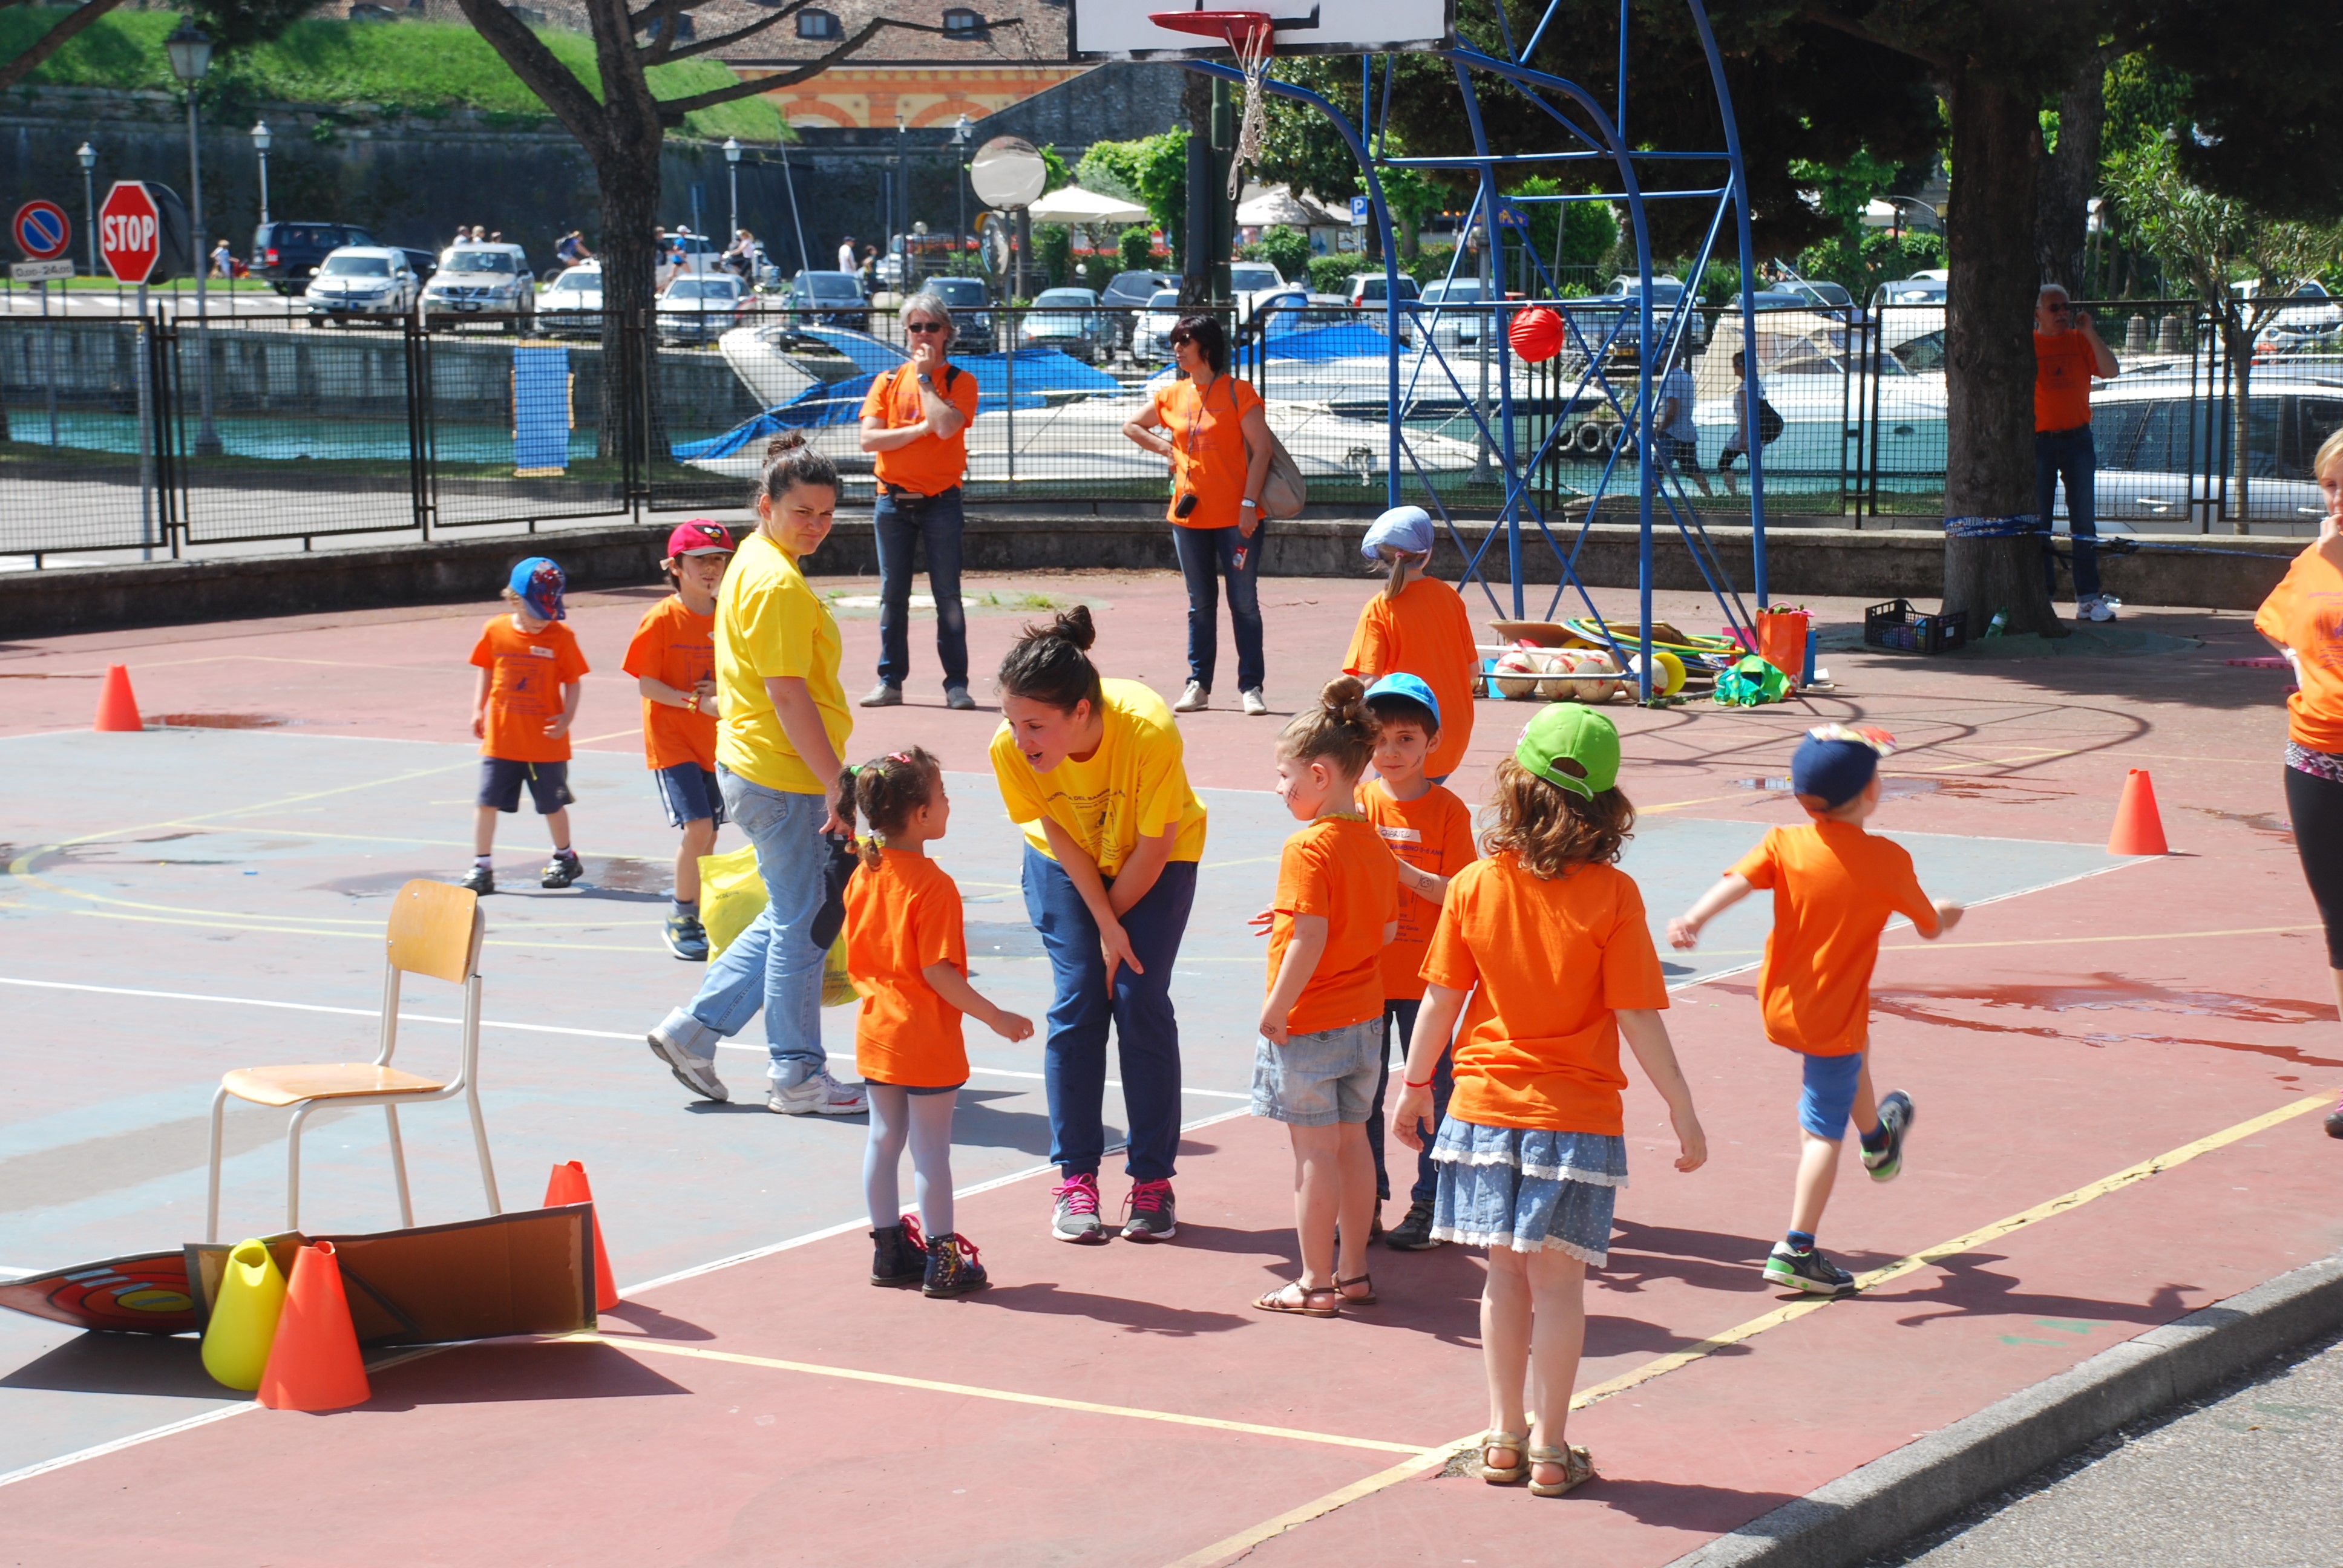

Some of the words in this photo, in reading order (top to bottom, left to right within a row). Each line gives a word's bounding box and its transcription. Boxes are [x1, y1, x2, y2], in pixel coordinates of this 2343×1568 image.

[1354, 199, 1364, 214] P
[104, 215, 156, 252] STOP
[1390, 843, 1419, 852] BAMBINO
